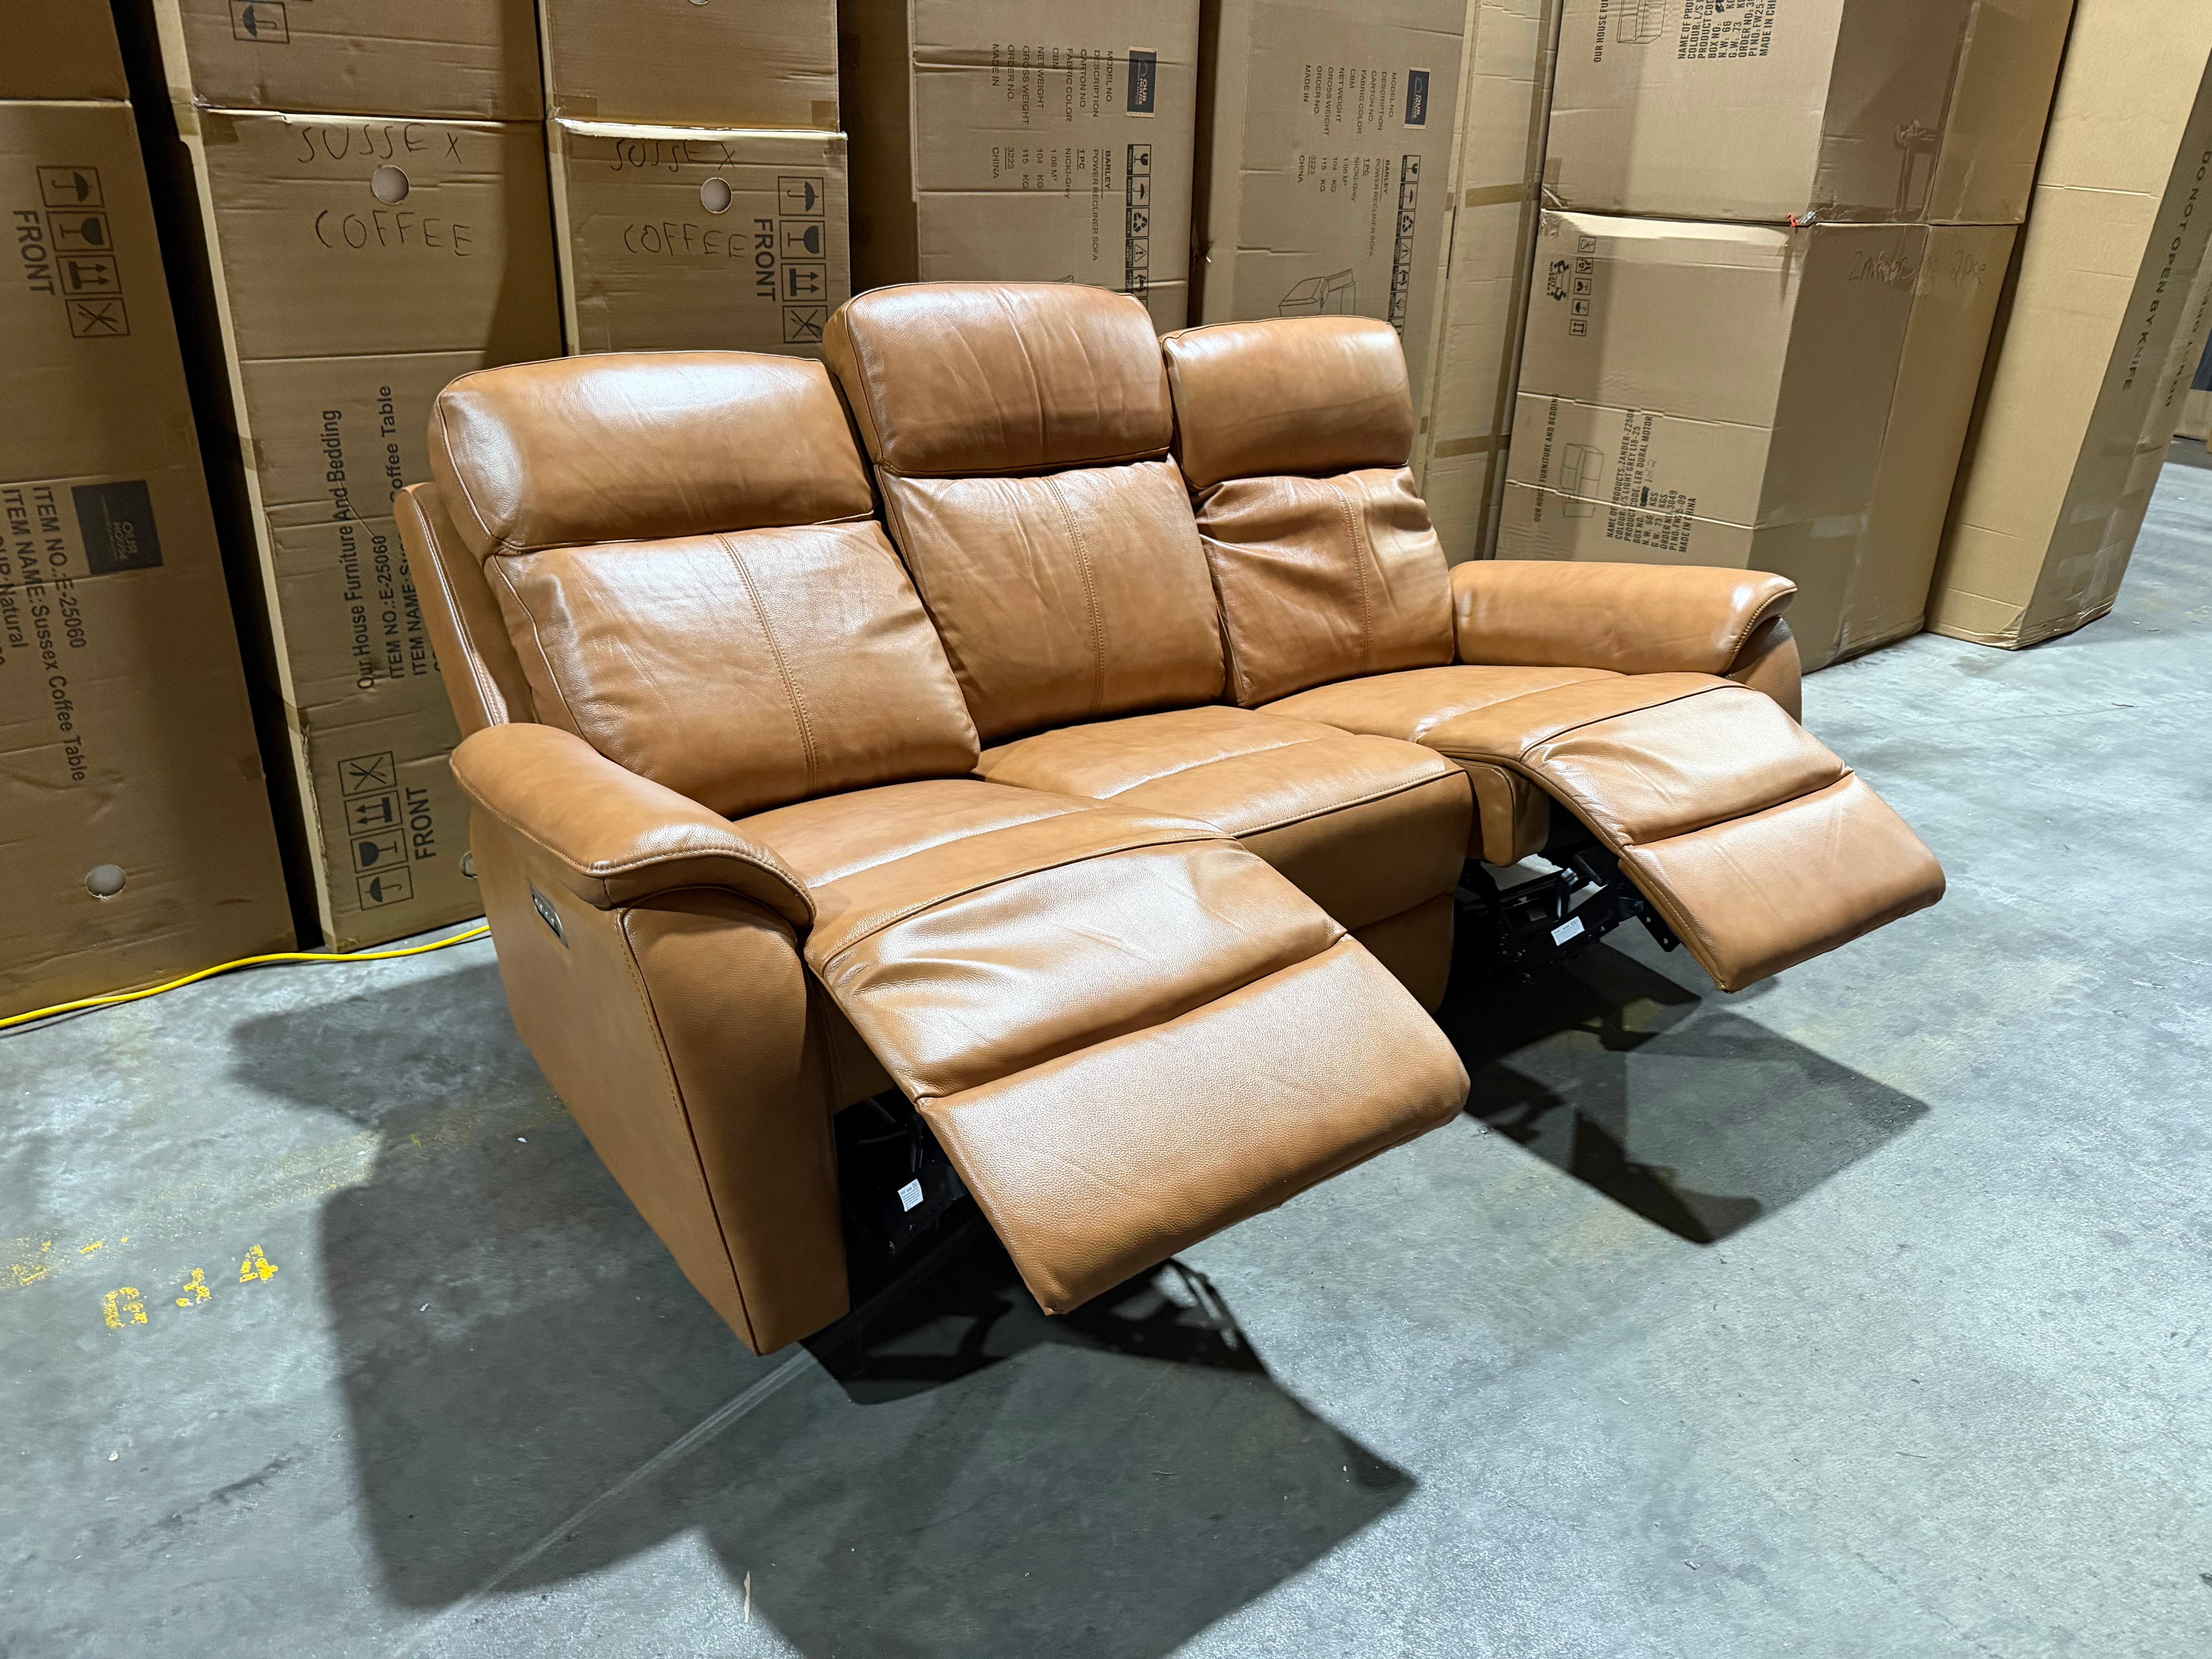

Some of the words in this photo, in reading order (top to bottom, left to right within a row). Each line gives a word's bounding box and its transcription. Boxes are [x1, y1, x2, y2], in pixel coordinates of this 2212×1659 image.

[1600, 0, 1608, 13] FU
[1683, 0, 1694, 19] PRO
[1596, 15, 1607, 43] HOUSE
[1681, 21, 1690, 32] OF
[1712, 23, 1721, 39] NO:
[1722, 21, 1731, 32] 66
[1732, 22, 1741, 31] 73
[1738, 28, 1750, 58] ORDER
[1744, 10, 1753, 25] NO:
[1764, 19, 1773, 28] IN
[1677, 34, 1688, 59] NAME
[1698, 18, 1712, 58] PRODUCT
[1708, 41, 1719, 58] BOX
[1718, 38, 1729, 58] N.W:
[1728, 38, 1740, 58] G.W:
[1759, 31, 1771, 56] MADE
[1594, 45, 1603, 62] OUR
[1748, 48, 1757, 56] PI
[992, 76, 999, 86] IN
[1304, 93, 1309, 102] IN
[1377, 71, 1386, 131] DESCRIPTION
[297, 124, 463, 164] SUSSEX
[1079, 156, 1085, 170] PC
[1364, 164, 1370, 176] PC
[2196, 151, 2212, 181] DO
[1022, 175, 1029, 189] KG
[1037, 175, 1043, 189] KG
[1320, 180, 1326, 192] KG
[1331, 180, 1336, 192] KG
[2178, 187, 2200, 232] NOT
[316, 210, 473, 256] COFFEE
[624, 222, 748, 258] COFFEE
[13, 210, 55, 296] FRONT
[754, 219, 776, 302] FRONT
[2156, 236, 2181, 294] OPEN
[2146, 300, 2159, 326] BY
[2122, 331, 2149, 392] KNIFE
[377, 386, 396, 438] Table
[1642, 416, 1653, 441] MOTOR
[321, 410, 345, 483] Bedding
[1637, 444, 1648, 467] DURAL
[1533, 508, 1542, 522] OUR
[1539, 443, 1551, 483] FURNITURE
[1545, 427, 1554, 442] AND
[1626, 453, 1636, 471] GREY
[1622, 473, 1632, 493] LIGHT
[33, 487, 60, 532] ITEM
[329, 488, 351, 521] And
[1609, 506, 1618, 516] OF
[1649, 492, 1658, 507] KGS
[1659, 494, 1668, 508] KGS
[1606, 517, 1616, 538] NAME
[1624, 509, 1636, 541] PRODUCT
[1646, 515, 1654, 525] 66
[1660, 525, 1671, 549] ORDER
[1667, 490, 1678, 509] 3049
[1678, 531, 1690, 553] MADE
[1685, 498, 1696, 521] CHINA
[122, 521, 137, 554] OUR
[1633, 529, 1642, 544] BOX
[339, 526, 362, 601] Furniture
[3, 489, 31, 535] ITEM
[49, 676, 74, 732] Coffee
[64, 735, 87, 781] Table
[352, 605, 370, 656] House
[388, 640, 405, 679] ITEM
[409, 637, 427, 676] ITEM
[357, 660, 374, 689] Our
[406, 786, 436, 860] FRONT
